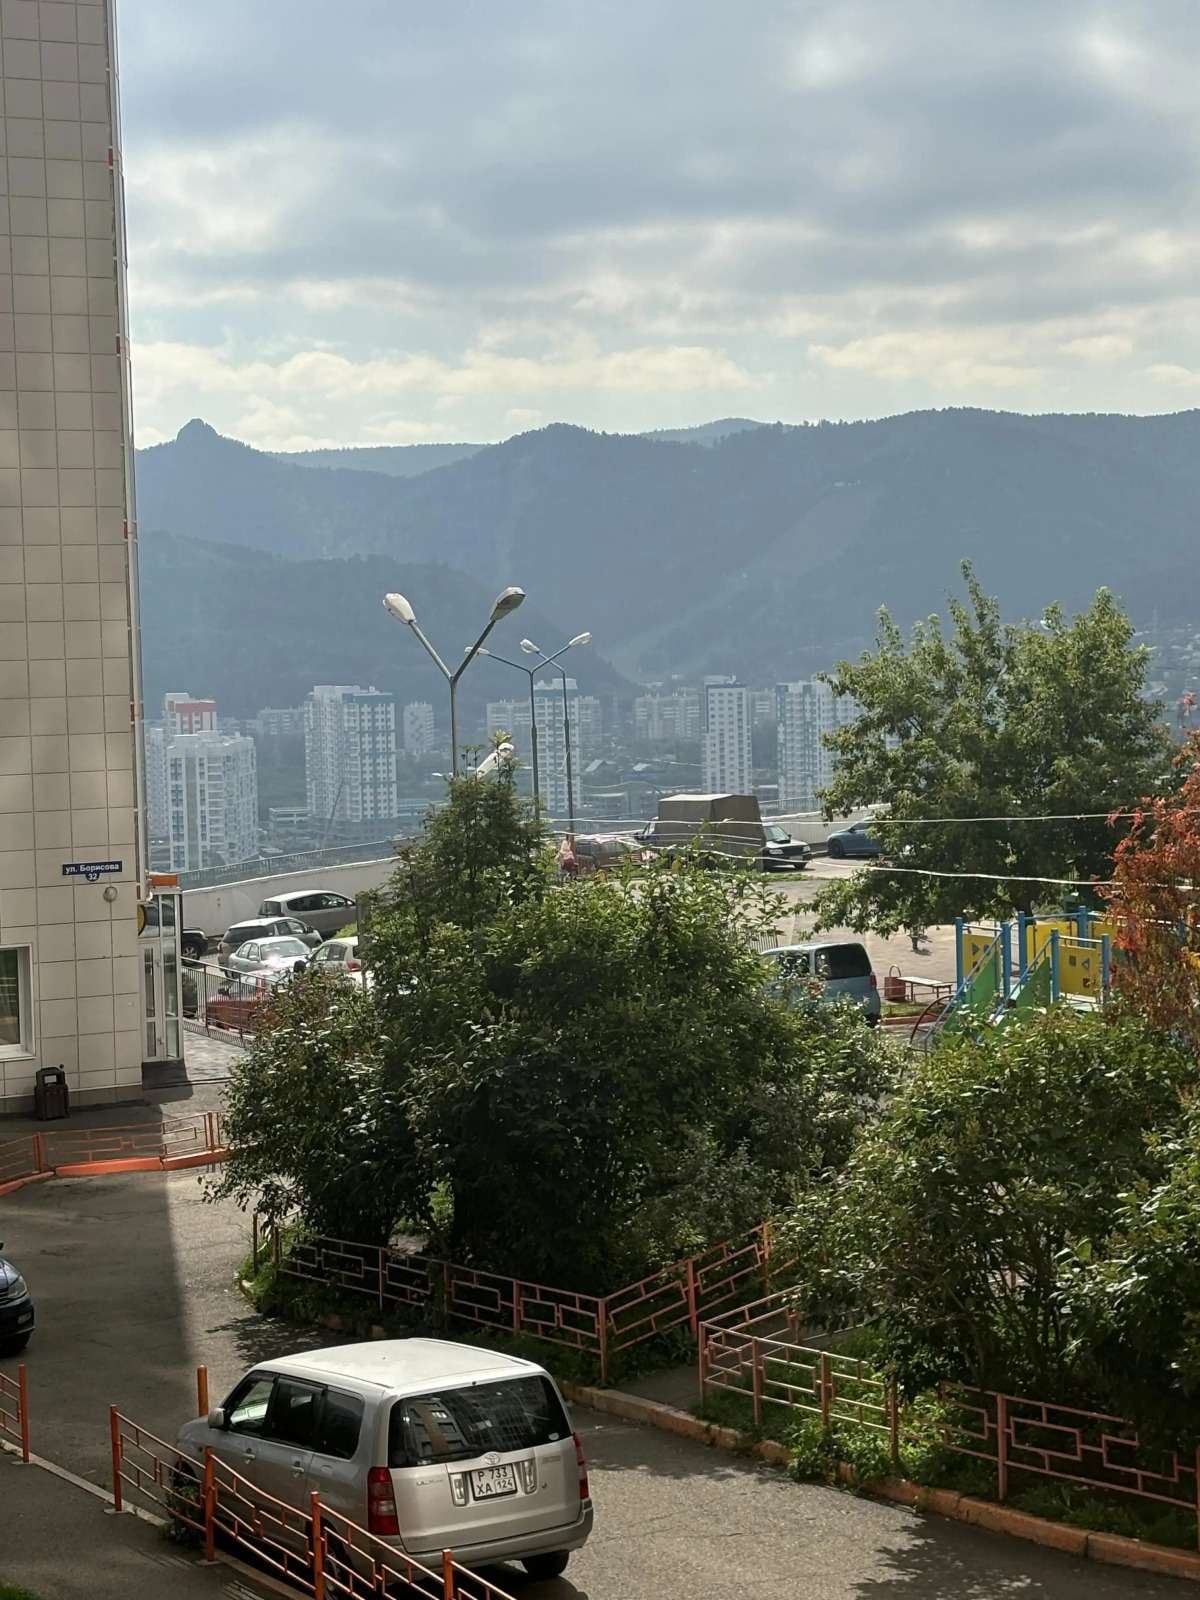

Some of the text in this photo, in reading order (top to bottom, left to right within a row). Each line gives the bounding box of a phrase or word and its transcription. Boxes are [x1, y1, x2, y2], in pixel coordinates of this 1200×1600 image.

[65, 864, 119, 874] ул. Борисова
[488, 1467, 508, 1480] 733
[496, 1480, 513, 1490] 124
